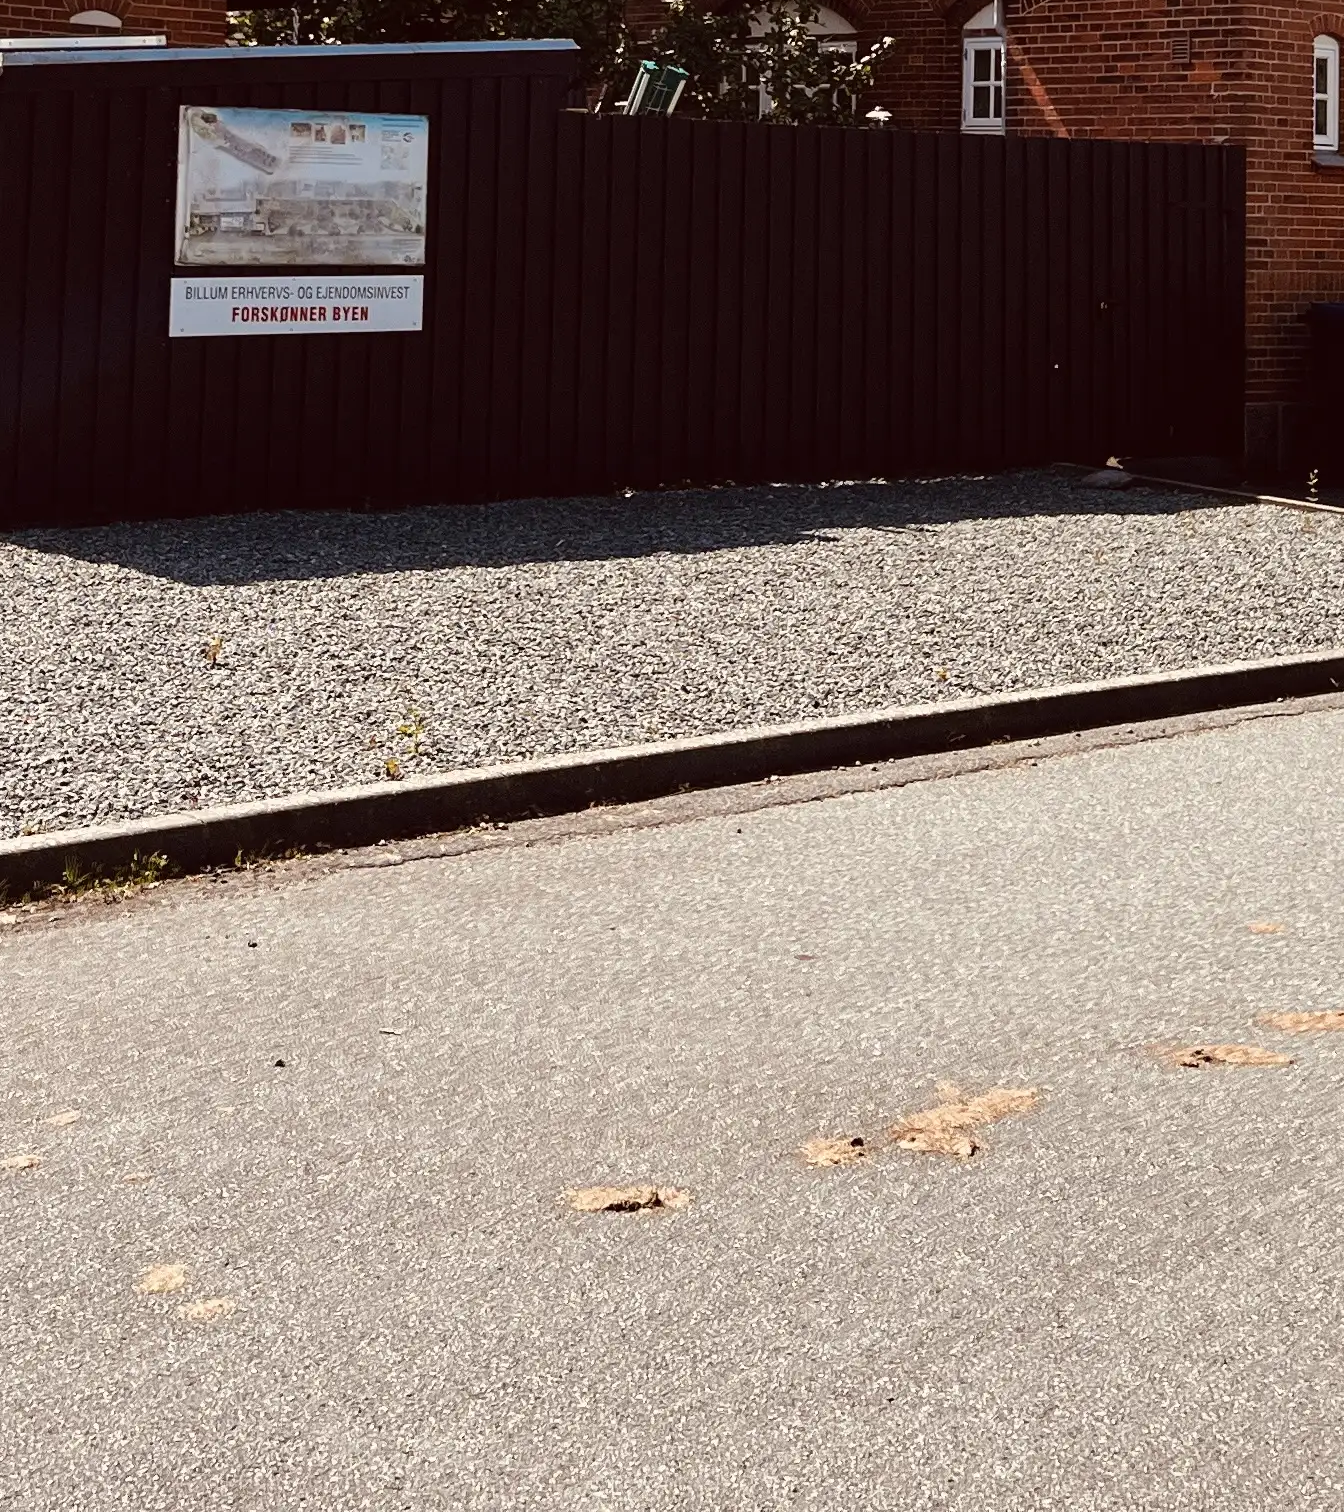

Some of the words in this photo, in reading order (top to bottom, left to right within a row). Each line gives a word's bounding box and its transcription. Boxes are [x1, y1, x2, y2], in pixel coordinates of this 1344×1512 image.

[185, 286, 228, 300] BILLUM
[231, 286, 294, 300] ERHVERVS-
[297, 286, 313, 299] OG
[316, 286, 410, 299] EJENDOMSINVEST
[232, 306, 327, 323] FORSKØNNER
[332, 306, 369, 321] BYEN
